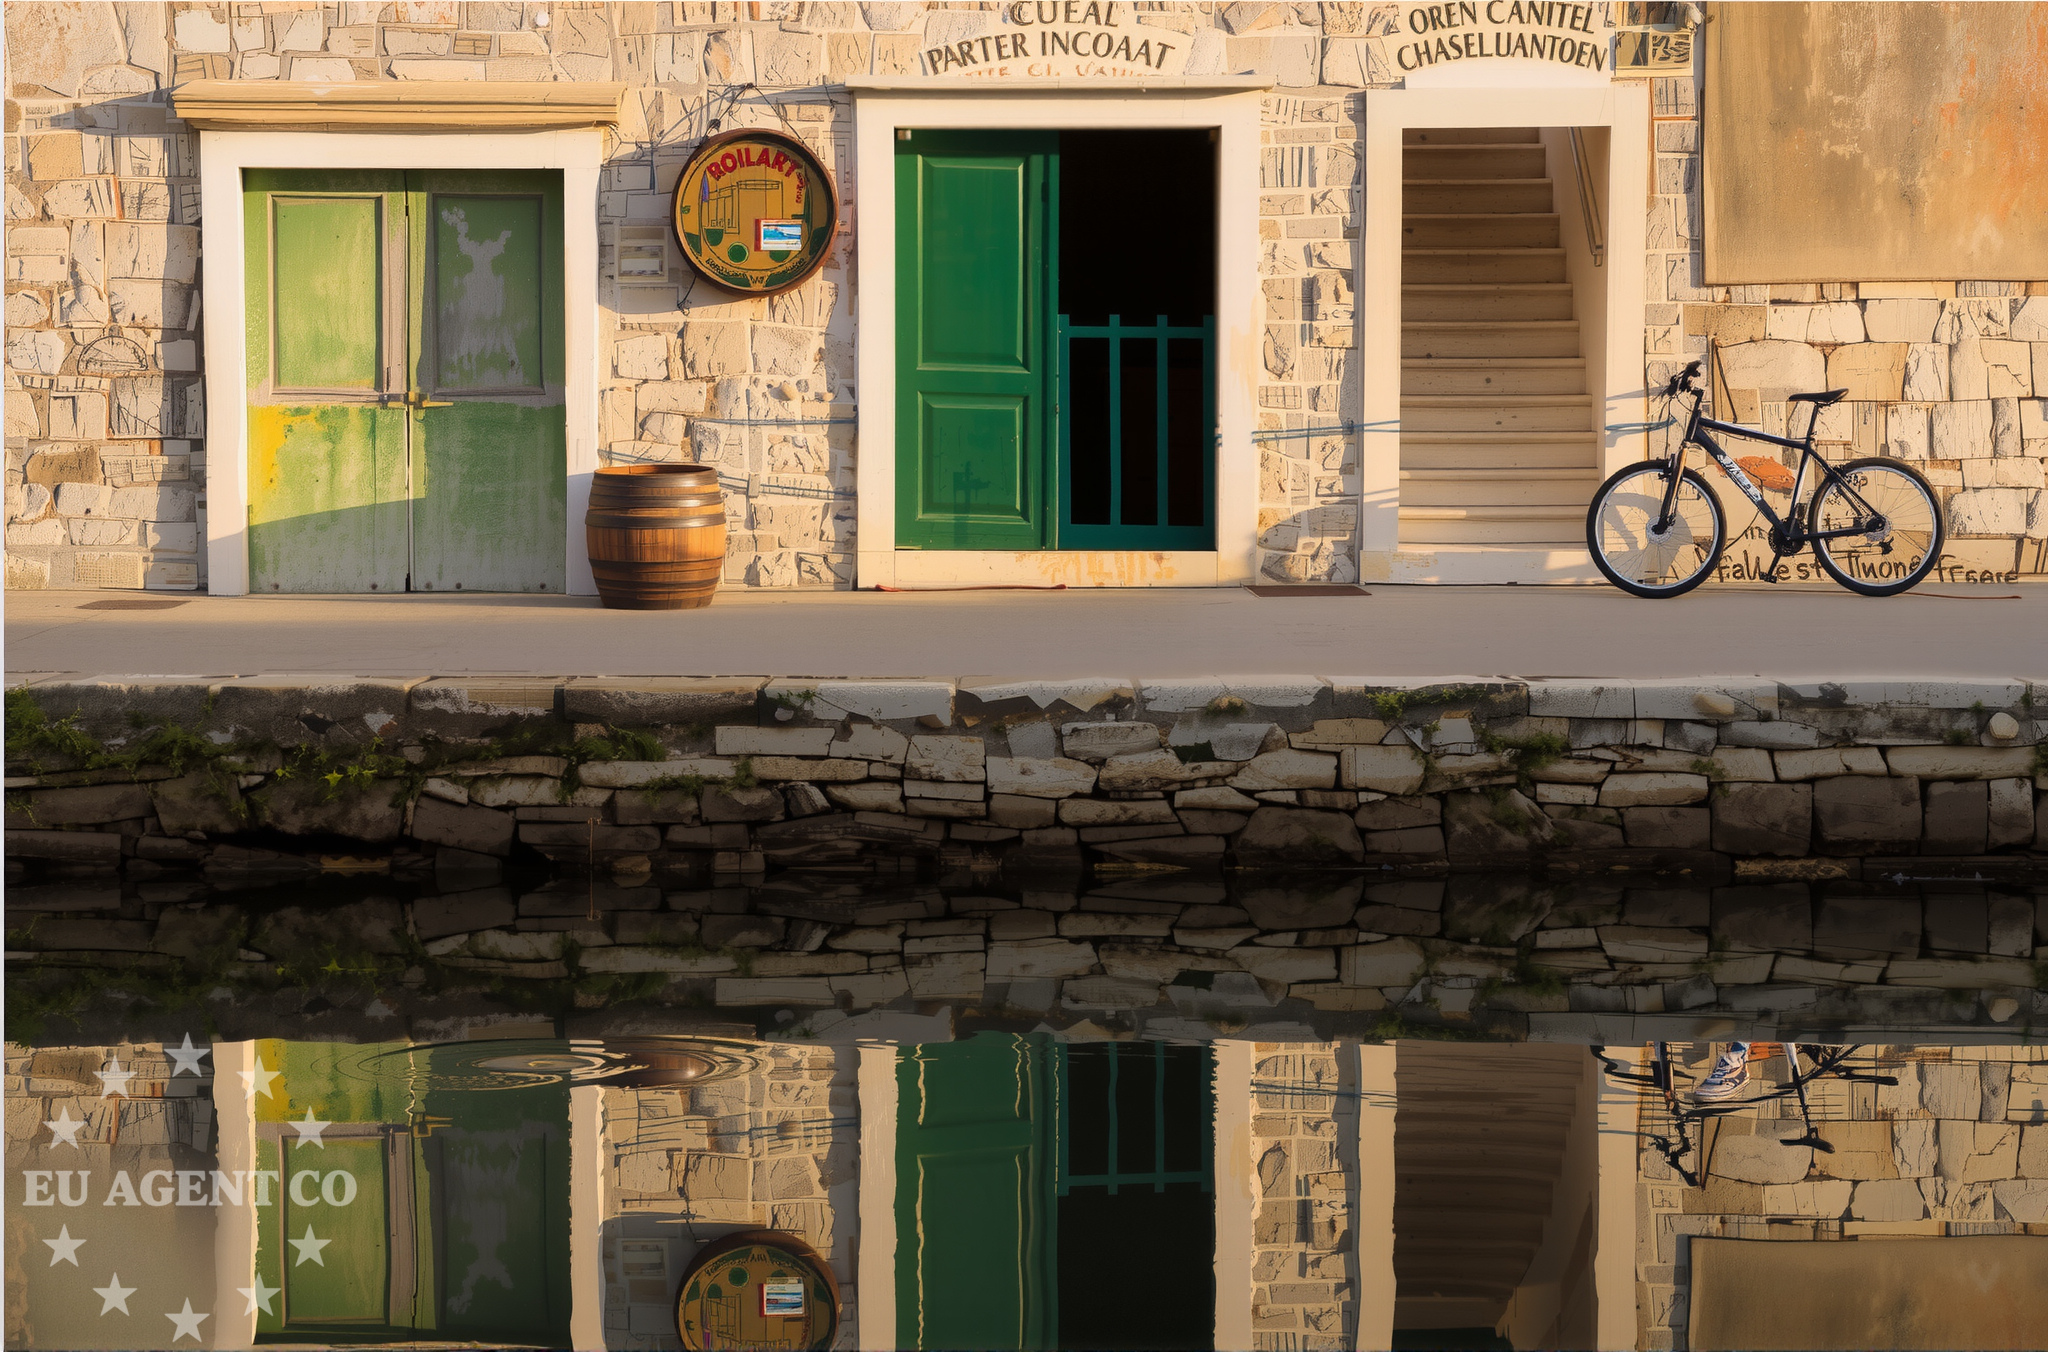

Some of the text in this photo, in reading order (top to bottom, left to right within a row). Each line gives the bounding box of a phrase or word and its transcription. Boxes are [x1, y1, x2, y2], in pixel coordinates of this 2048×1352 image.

[1409, 1, 1594, 35] OREN CANITEL
[927, 31, 1176, 75] PARTER INCOAAT
